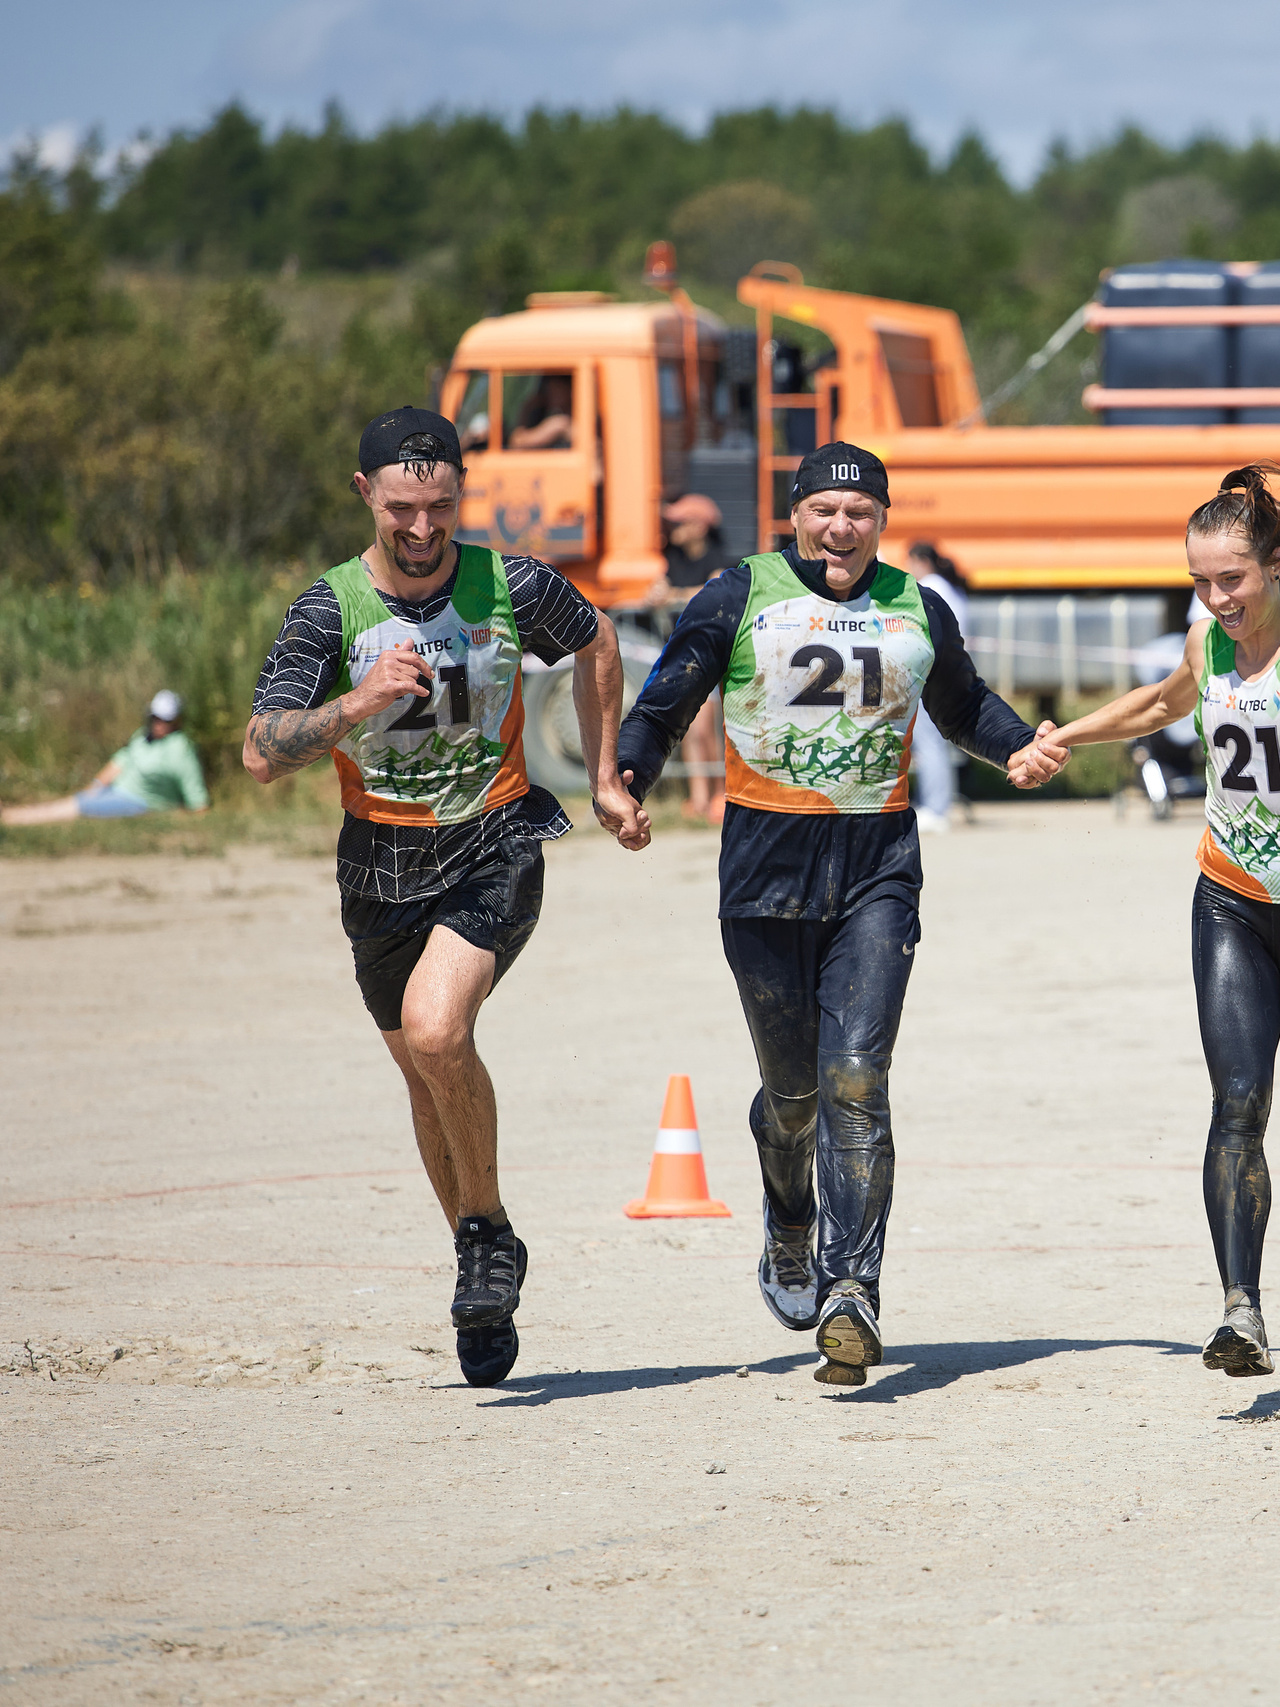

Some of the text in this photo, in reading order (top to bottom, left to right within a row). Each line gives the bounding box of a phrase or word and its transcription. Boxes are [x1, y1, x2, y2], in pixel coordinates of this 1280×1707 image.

[830, 463, 861, 481] 100
[828, 620, 867, 634] ЦТВС
[885, 617, 905, 633] ЦСП
[471, 628, 492, 646] ЦСП
[785, 643, 884, 707] 21
[1239, 699, 1267, 712] ЦТВС
